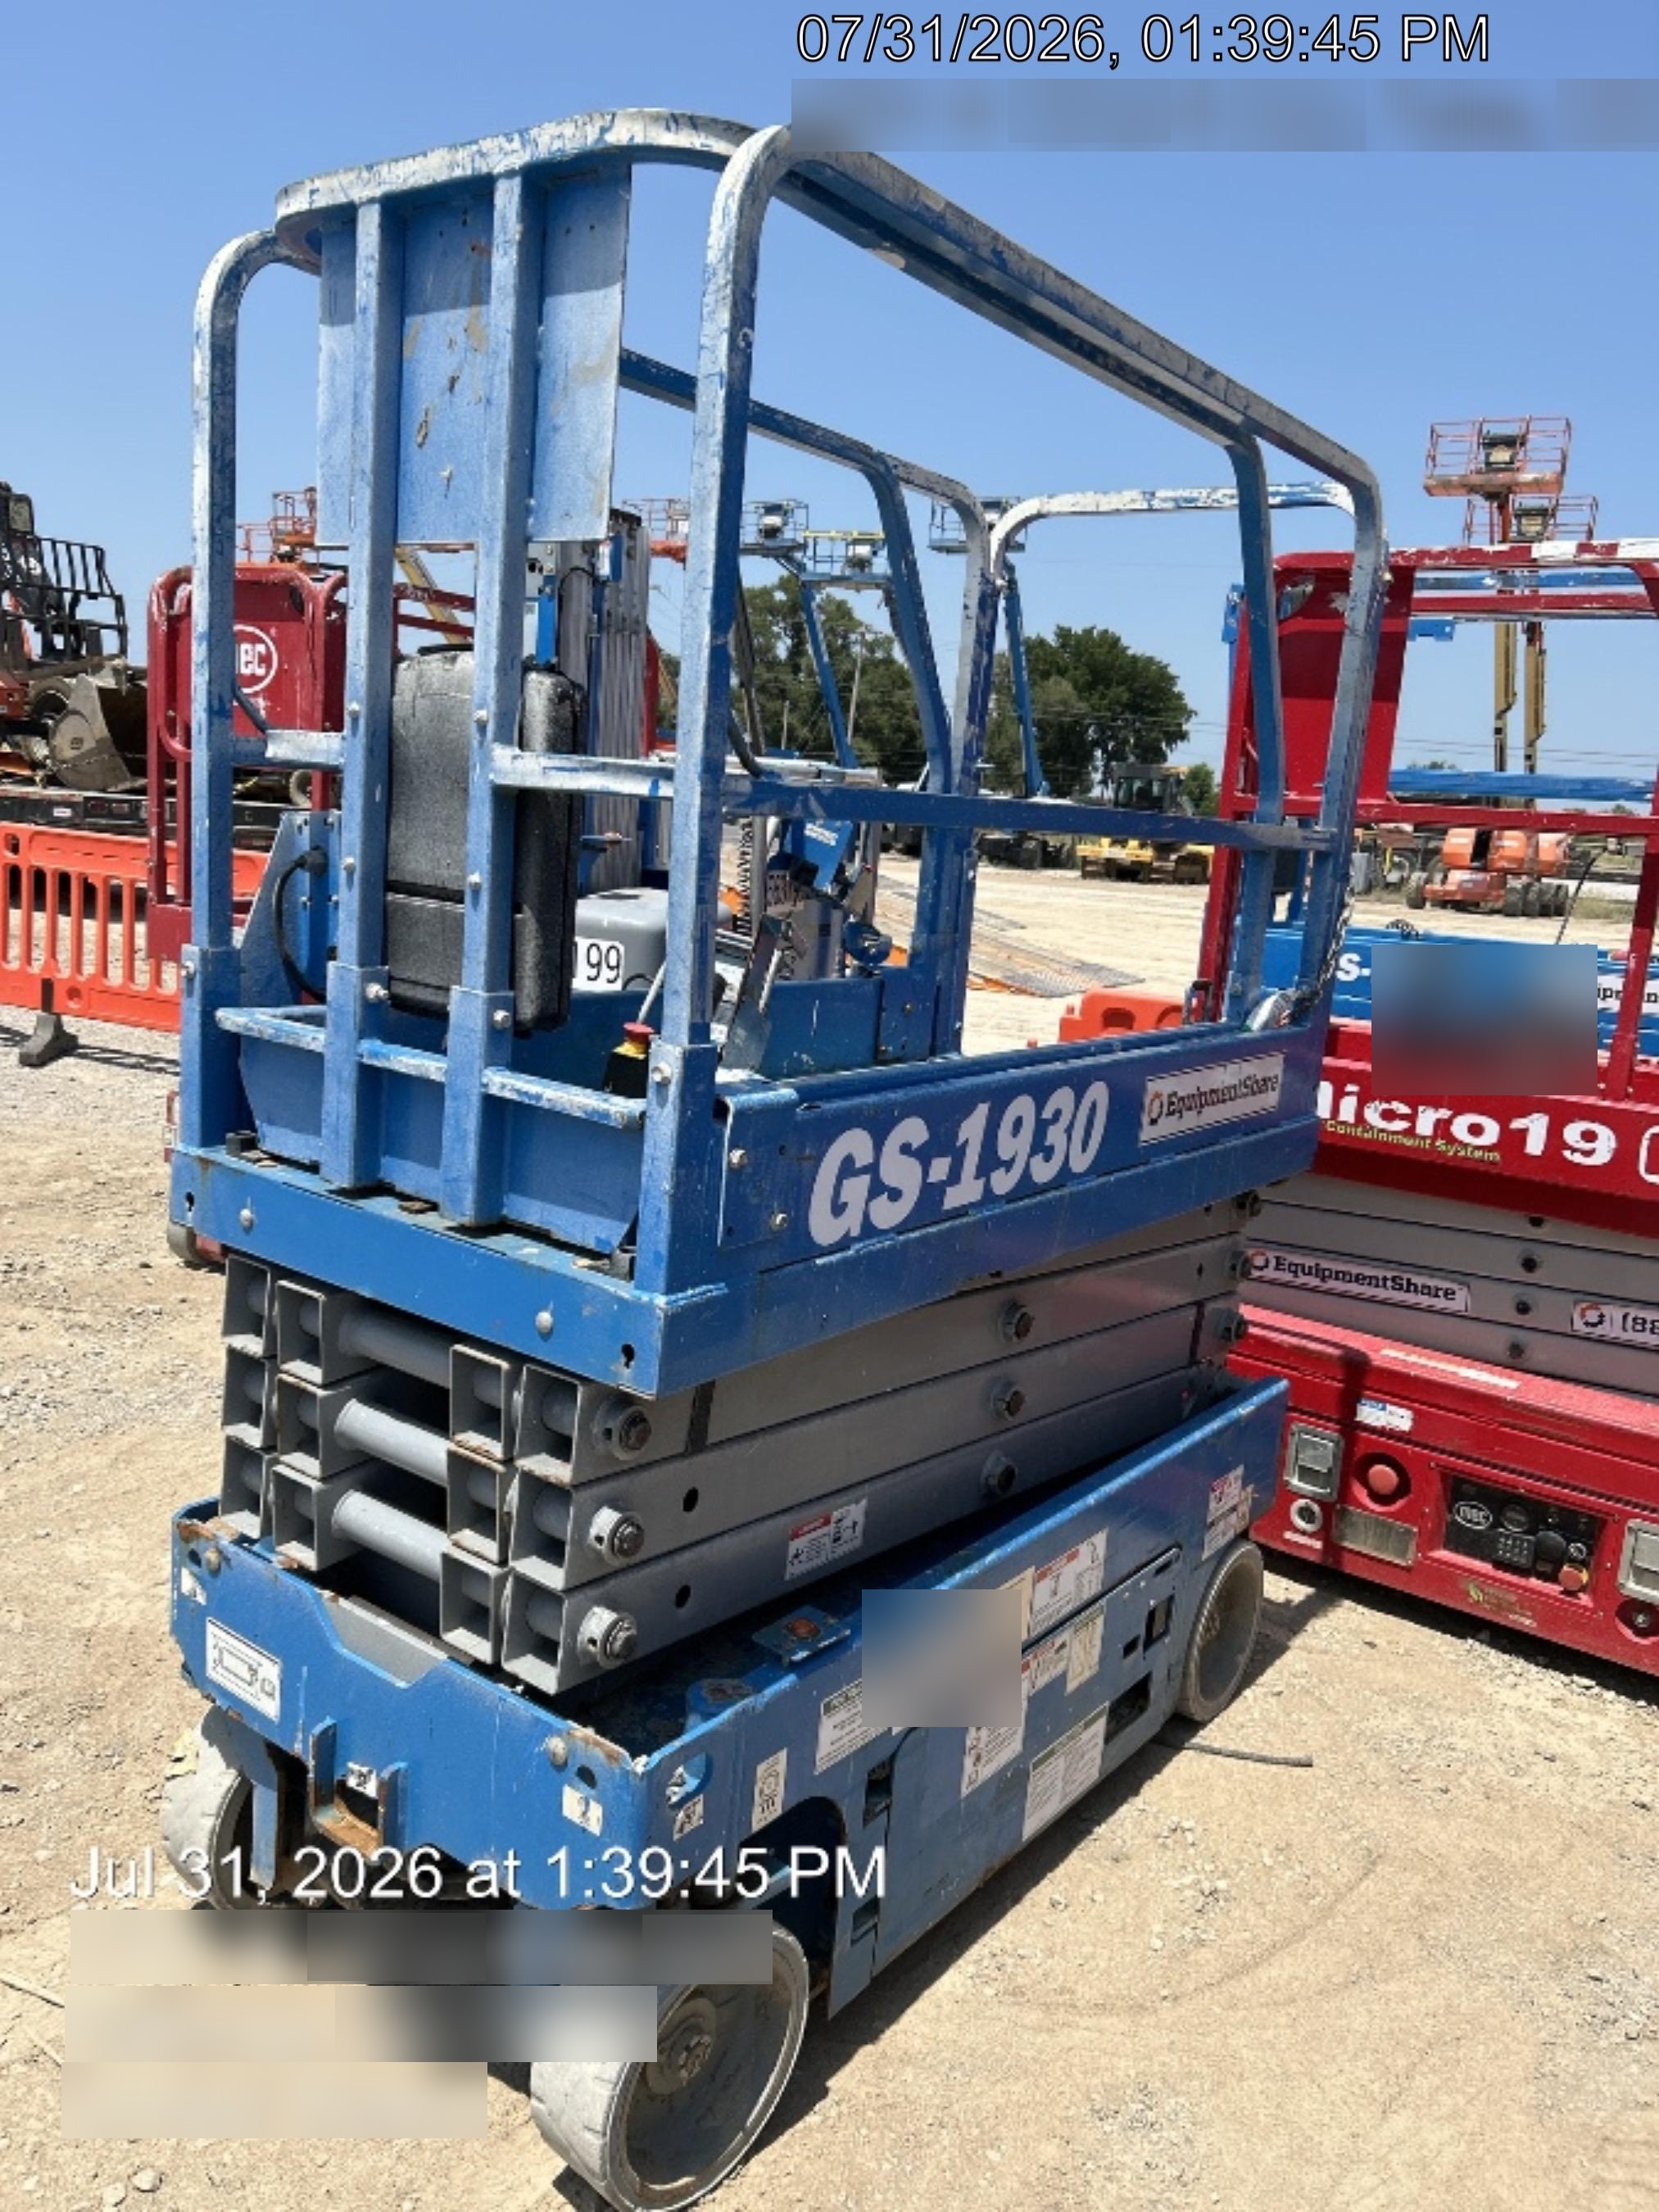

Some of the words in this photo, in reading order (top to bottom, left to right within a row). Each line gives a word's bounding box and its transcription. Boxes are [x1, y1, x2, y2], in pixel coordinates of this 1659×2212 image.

[574, 941, 620, 983] 99
[1165, 1074, 1279, 1119] EquipmentShare
[808, 1081, 1109, 1247] GS-1930
[1435, 1137, 1501, 1163] System
[1273, 1256, 1457, 1301] EquipmentShare
